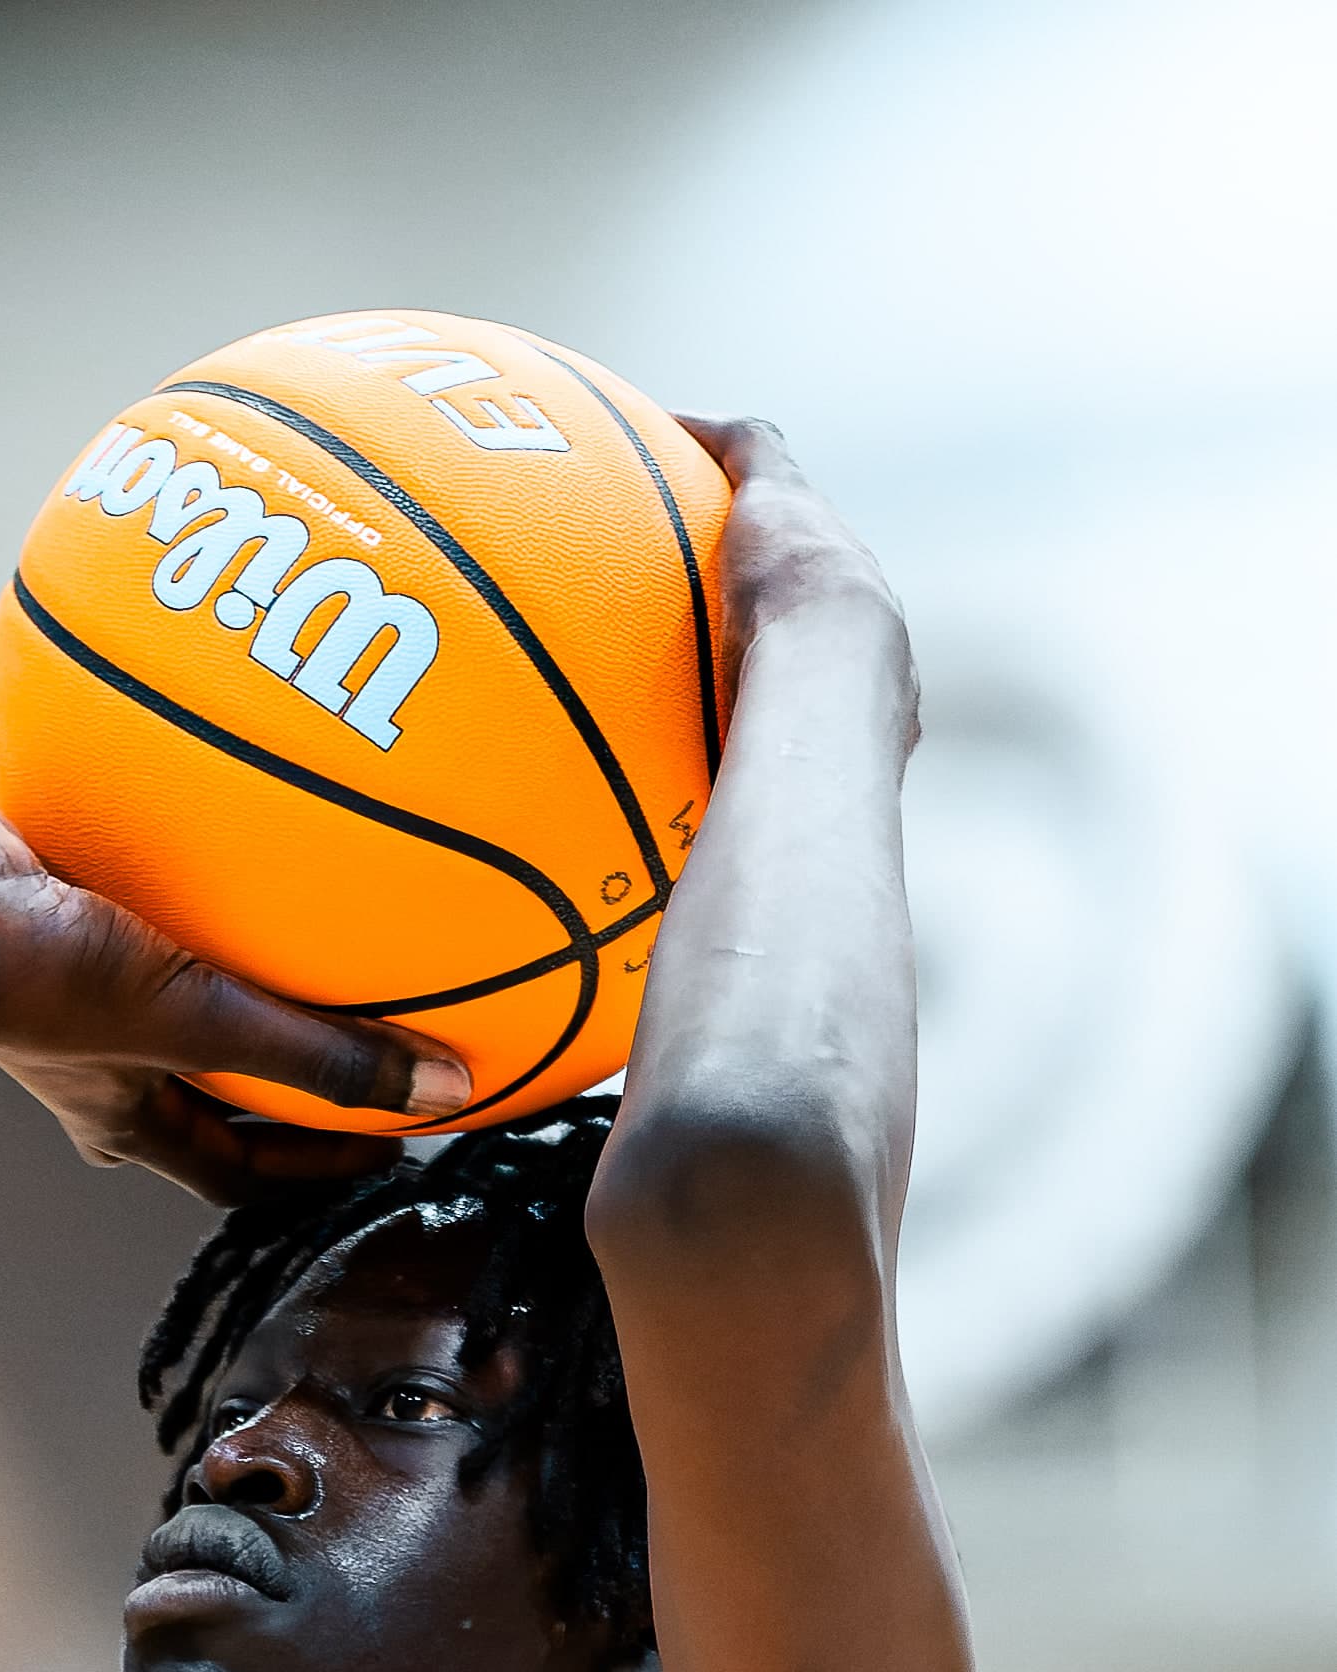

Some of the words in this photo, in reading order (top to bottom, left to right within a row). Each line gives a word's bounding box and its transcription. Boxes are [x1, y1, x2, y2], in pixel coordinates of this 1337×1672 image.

[209, 431, 272, 473] GAME
[277, 469, 381, 547] OFFICIAL
[64, 421, 439, 752] Wilson
